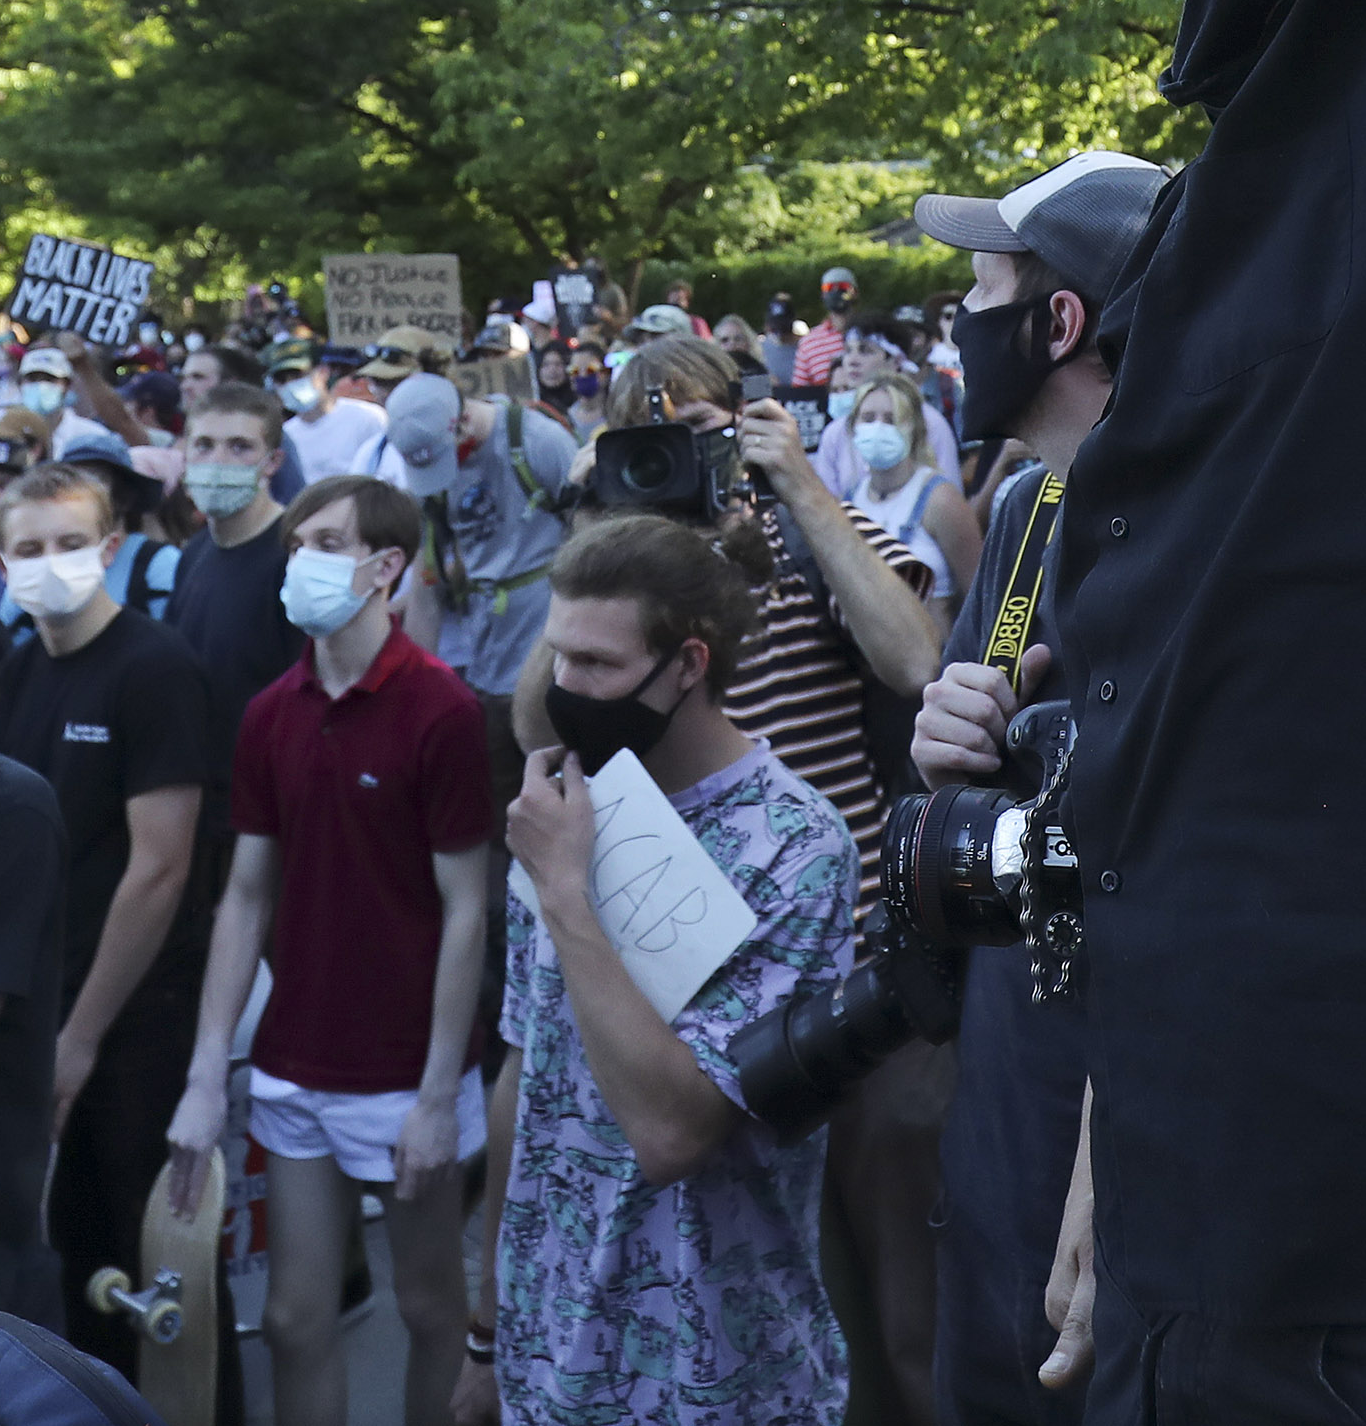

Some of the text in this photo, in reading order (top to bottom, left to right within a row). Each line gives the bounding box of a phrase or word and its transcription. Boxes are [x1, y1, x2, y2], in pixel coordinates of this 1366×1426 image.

[24, 234, 154, 305] BLACK LIVES
[10, 276, 138, 346] MATTER
[992, 596, 1031, 659] D850
